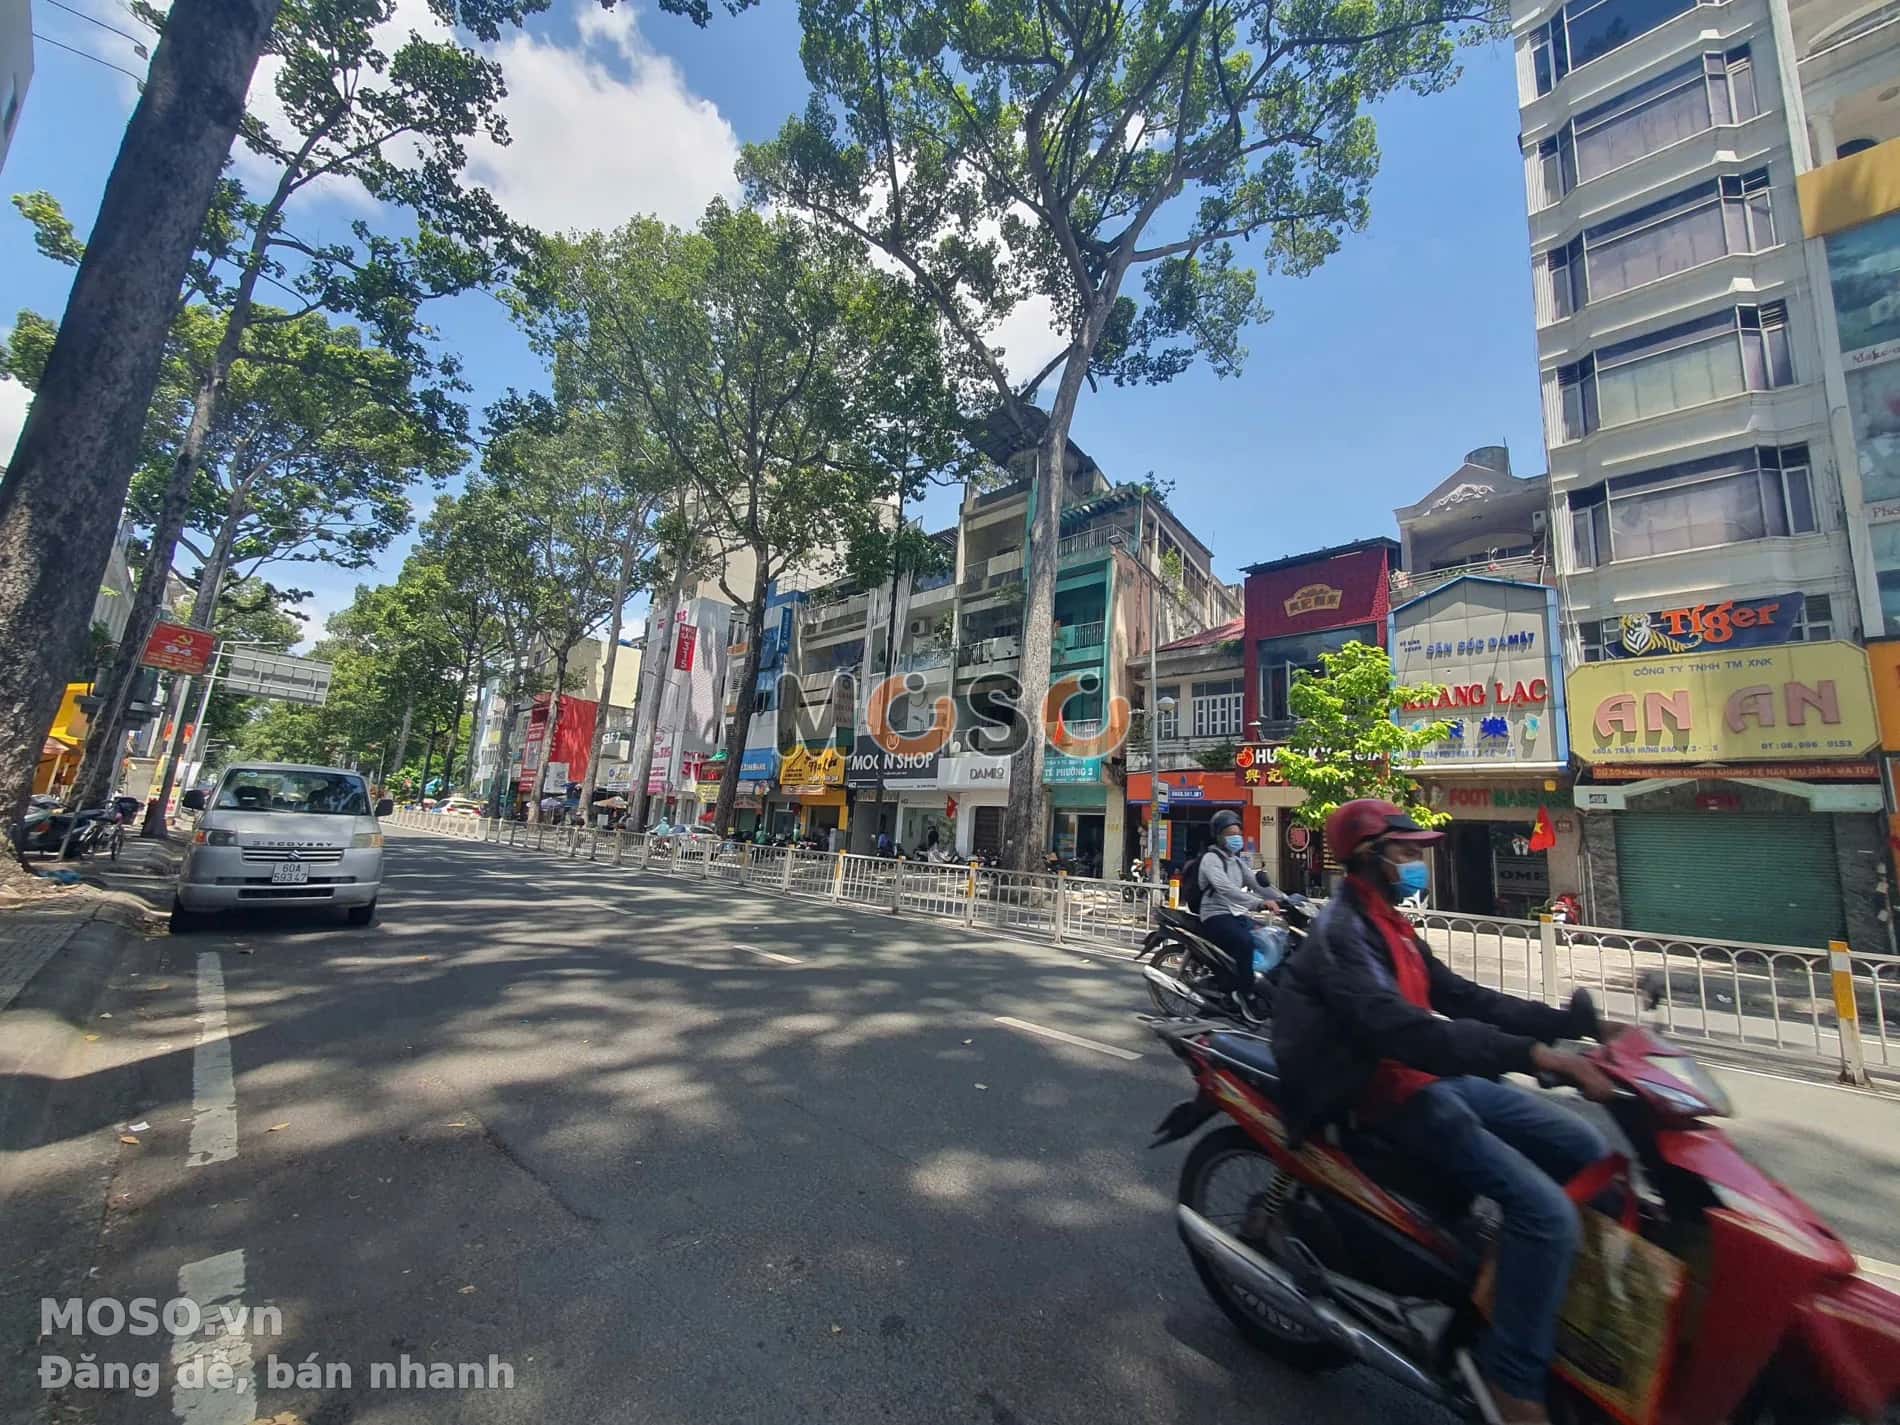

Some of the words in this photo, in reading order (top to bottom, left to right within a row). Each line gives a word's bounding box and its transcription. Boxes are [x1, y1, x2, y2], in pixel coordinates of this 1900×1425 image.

[1661, 600, 1780, 642] Tiger
[1458, 637, 1484, 652] SÓC
[1633, 667, 1664, 677] CÔNG
[1670, 665, 1682, 673] TY
[1688, 664, 1720, 672] TNHH
[1725, 660, 1742, 669] TM
[1748, 658, 1774, 667] XNK
[1402, 684, 1487, 712] ANG
[1494, 679, 1549, 707] LẠC
[1595, 689, 1692, 737] AN
[1725, 679, 1841, 734] AN
[896, 752, 934, 769] SHOP
[1449, 788, 1489, 806] FOOT
[282, 863, 301, 873] 60A
